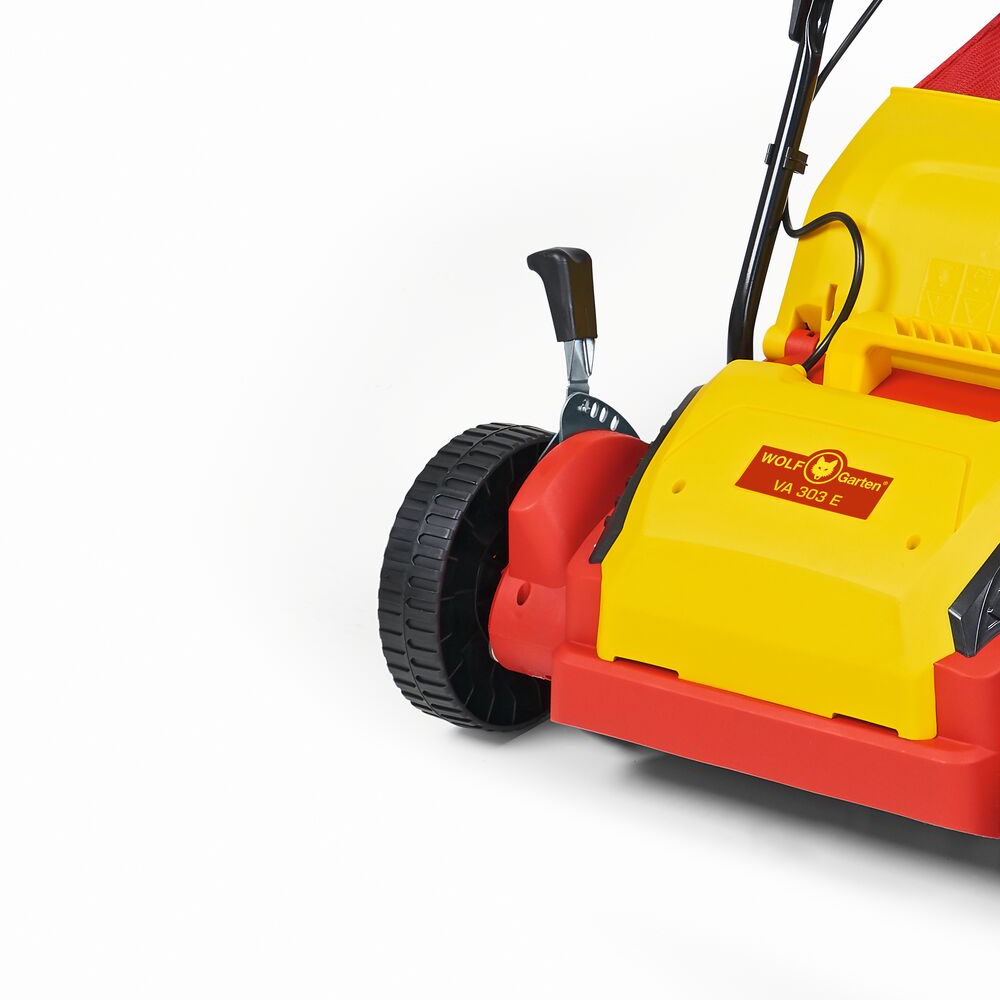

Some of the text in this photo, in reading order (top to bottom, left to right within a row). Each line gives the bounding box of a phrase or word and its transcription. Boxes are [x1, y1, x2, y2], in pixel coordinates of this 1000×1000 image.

[761, 451, 806, 471] WOLF
[773, 479, 844, 507] VA 303 E
